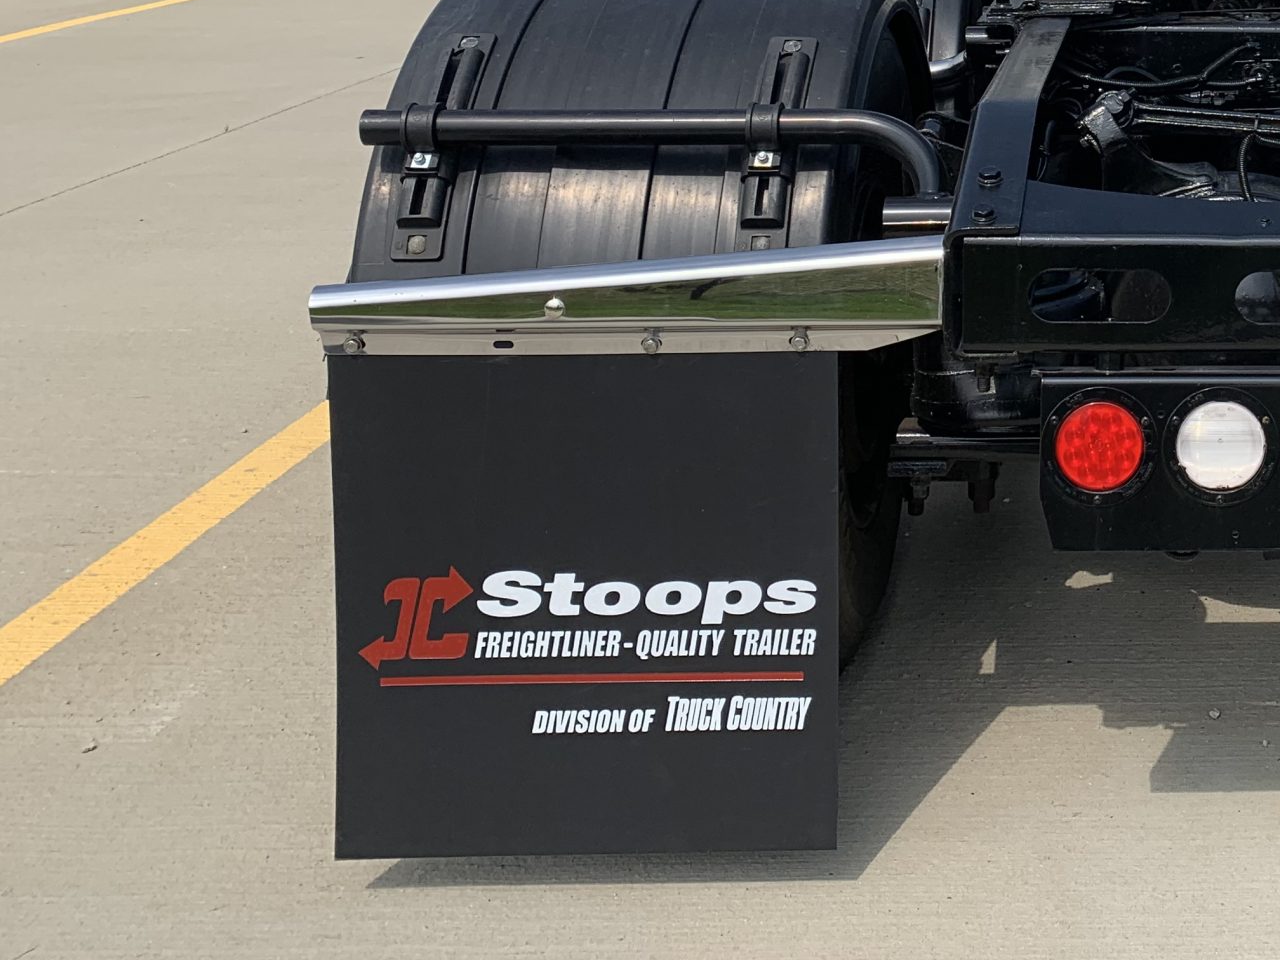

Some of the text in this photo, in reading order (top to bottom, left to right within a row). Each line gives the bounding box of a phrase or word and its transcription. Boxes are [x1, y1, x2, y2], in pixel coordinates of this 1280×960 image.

[476, 570, 817, 625] Stoops
[733, 628, 817, 656] TRAILER
[532, 695, 812, 733] DIVISION OF TRUCK COUNTRY
